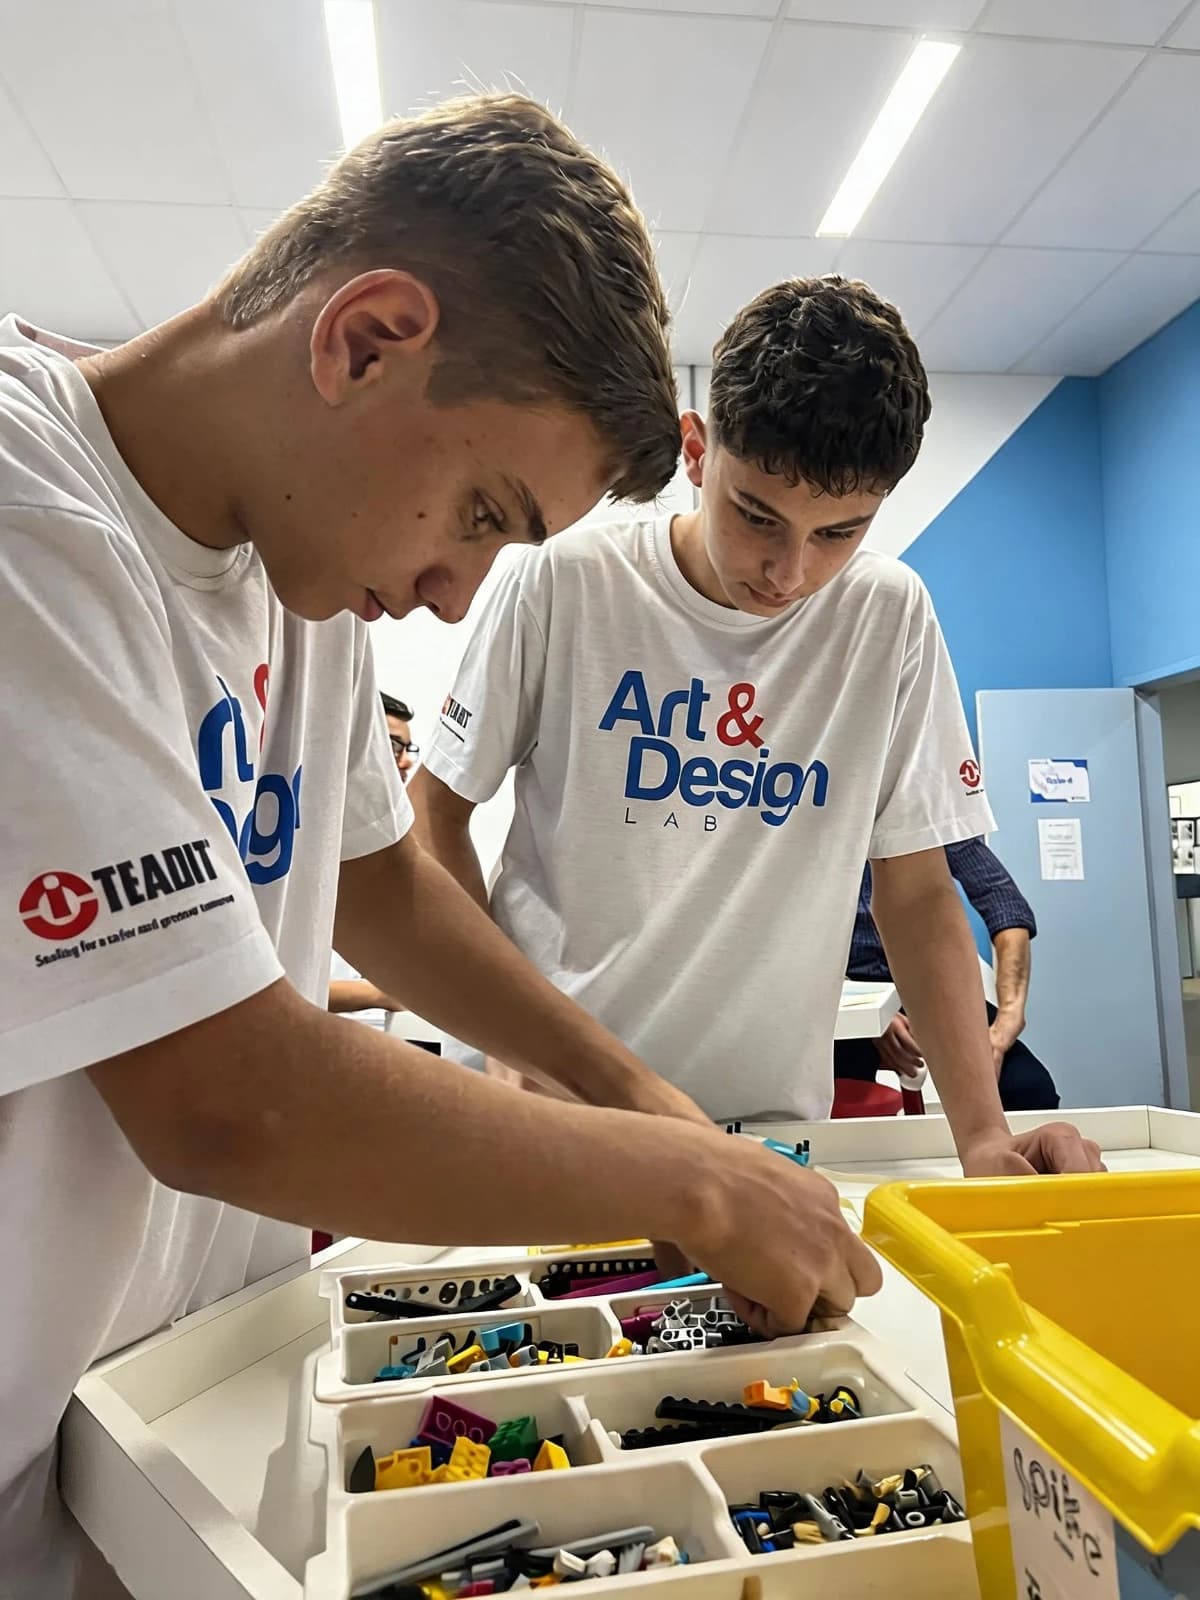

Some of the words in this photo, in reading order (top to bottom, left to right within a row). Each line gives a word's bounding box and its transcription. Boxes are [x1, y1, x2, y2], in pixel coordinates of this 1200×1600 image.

[598, 670, 711, 742] Art
[717, 683, 765, 748] &
[624, 736, 829, 826] Design
[624, 807, 718, 832] LAB
[91, 839, 218, 913] TEADIT
